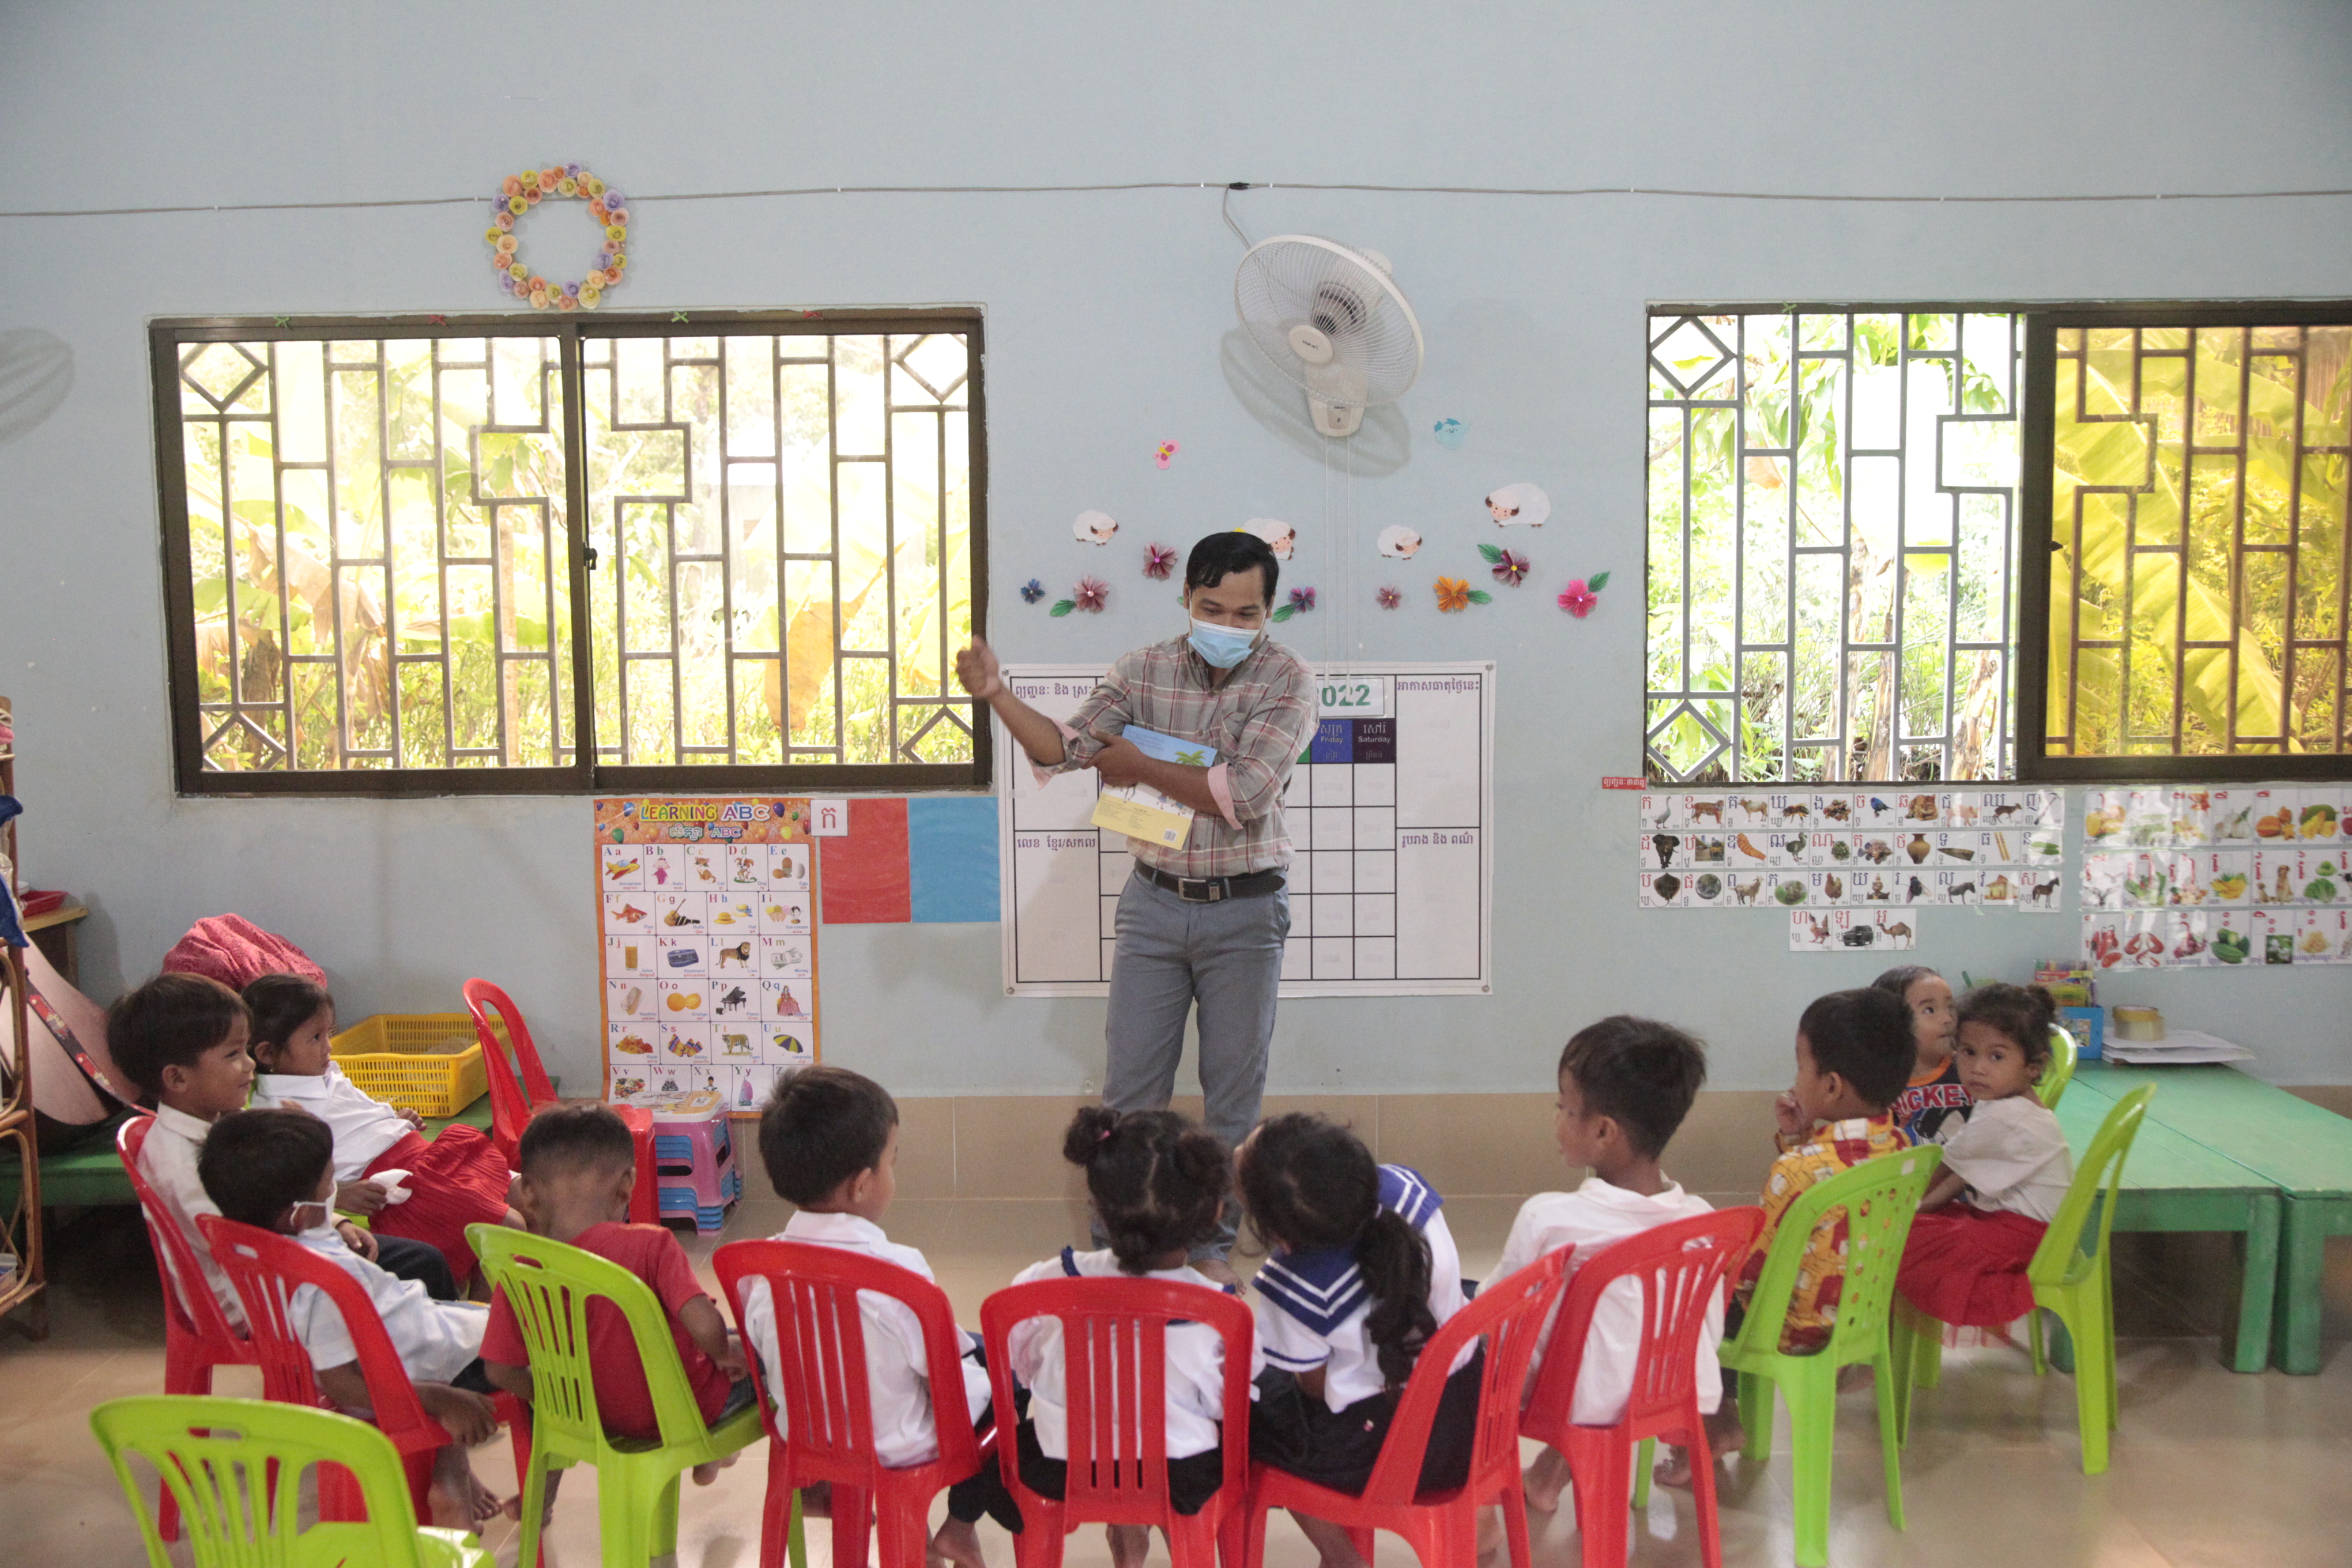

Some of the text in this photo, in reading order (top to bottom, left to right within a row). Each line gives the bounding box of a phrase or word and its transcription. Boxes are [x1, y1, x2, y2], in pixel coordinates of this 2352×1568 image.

[1054, 683, 1069, 695] និង
[1317, 684, 1370, 707] 022
[1642, 796, 1652, 809] ក
[1685, 796, 1695, 809] ខ
[1728, 796, 1738, 809] គ
[1771, 796, 1787, 809] ឃ
[1814, 795, 1823, 810] ង
[1856, 795, 1865, 808] ច
[1899, 795, 1909, 808] ឆ
[1942, 794, 1951, 809] ជ
[1984, 794, 2006, 807] ឈ
[640, 805, 769, 820] LEARNING ABC
[821, 807, 836, 828] ក
[712, 827, 741, 838] ABC
[1981, 832, 1991, 846] ធ
[1017, 838, 1040, 848] លេខ
[1402, 831, 1473, 848] រូបរាង និង ពណ៌
[1641, 835, 1650, 850] ដ
[1684, 834, 1696, 850] ឋ
[1727, 835, 1736, 849] ឌ
[1770, 834, 1786, 847] ឍ
[1812, 834, 1833, 847] ណ
[1853, 834, 1863, 847] ត
[1897, 834, 1906, 848] ថ
[1939, 833, 1948, 846] ទ
[604, 847, 612, 855] A
[646, 846, 664, 855] B b
[687, 846, 695, 855] C
[729, 846, 747, 855] D d
[770, 846, 778, 855] E
[1641, 874, 1652, 887] ប
[1684, 874, 1693, 889] ផ
[1727, 873, 1736, 887] ព
[1767, 873, 1778, 887] ភ
[1811, 873, 1823, 886] ម
[1853, 872, 1868, 885] យ
[1895, 872, 1901, 885] រ
[1939, 872, 1955, 885] ល
[1980, 871, 1985, 887] វ
[2021, 872, 2037, 885] ស
[606, 894, 621, 903] F f
[657, 894, 675, 904] G g
[709, 894, 728, 903] H h
[762, 894, 772, 903] I i
[1792, 911, 1808, 925] ហ
[1835, 910, 1850, 929] ឡ
[1876, 910, 1887, 923] អ
[608, 937, 620, 948] J j
[659, 938, 677, 947] K k
[711, 938, 723, 947] L l
[762, 938, 772, 947] M
[609, 981, 617, 989] N
[659, 981, 669, 990] O
[712, 981, 727, 992] P p
[762, 980, 780, 991] Q q
[610, 1024, 619, 1032] R
[661, 1024, 668, 1032] S
[713, 1024, 721, 1032] T
[764, 1024, 771, 1032] U
[612, 1066, 620, 1075] V
[653, 1066, 665, 1075] W
[694, 1066, 702, 1075] X
[734, 1066, 751, 1076] Y y
